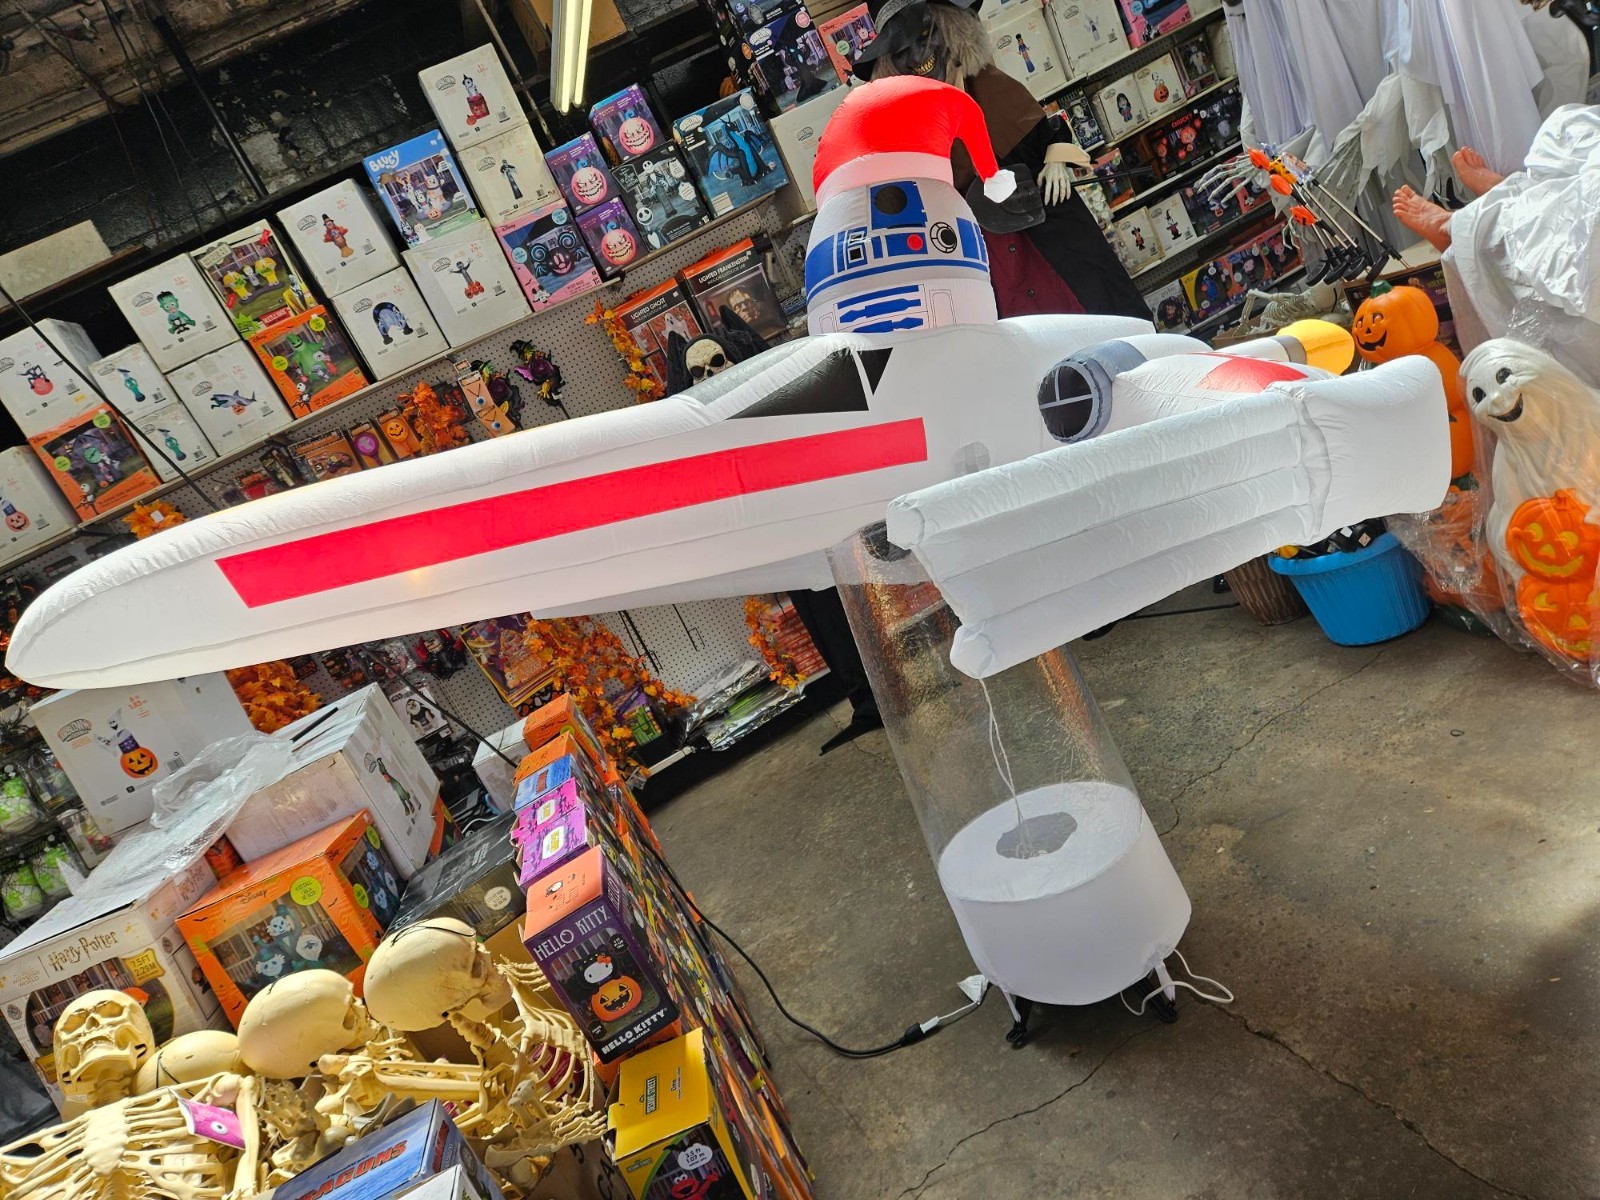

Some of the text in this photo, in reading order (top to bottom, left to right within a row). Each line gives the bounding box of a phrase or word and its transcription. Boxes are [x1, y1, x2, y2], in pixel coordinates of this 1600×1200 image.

[1171, 113, 1193, 128] CHUCKY
[699, 255, 749, 284] LIGHTED FRANKENSTEIN
[630, 297, 666, 320] LIGHTED GHOST
[532, 905, 609, 961] HELLO KITTY
[48, 931, 118, 972] Harry Potter
[601, 1029, 634, 1055] HELLO
[627, 1028, 651, 1044] INFLATABLE
